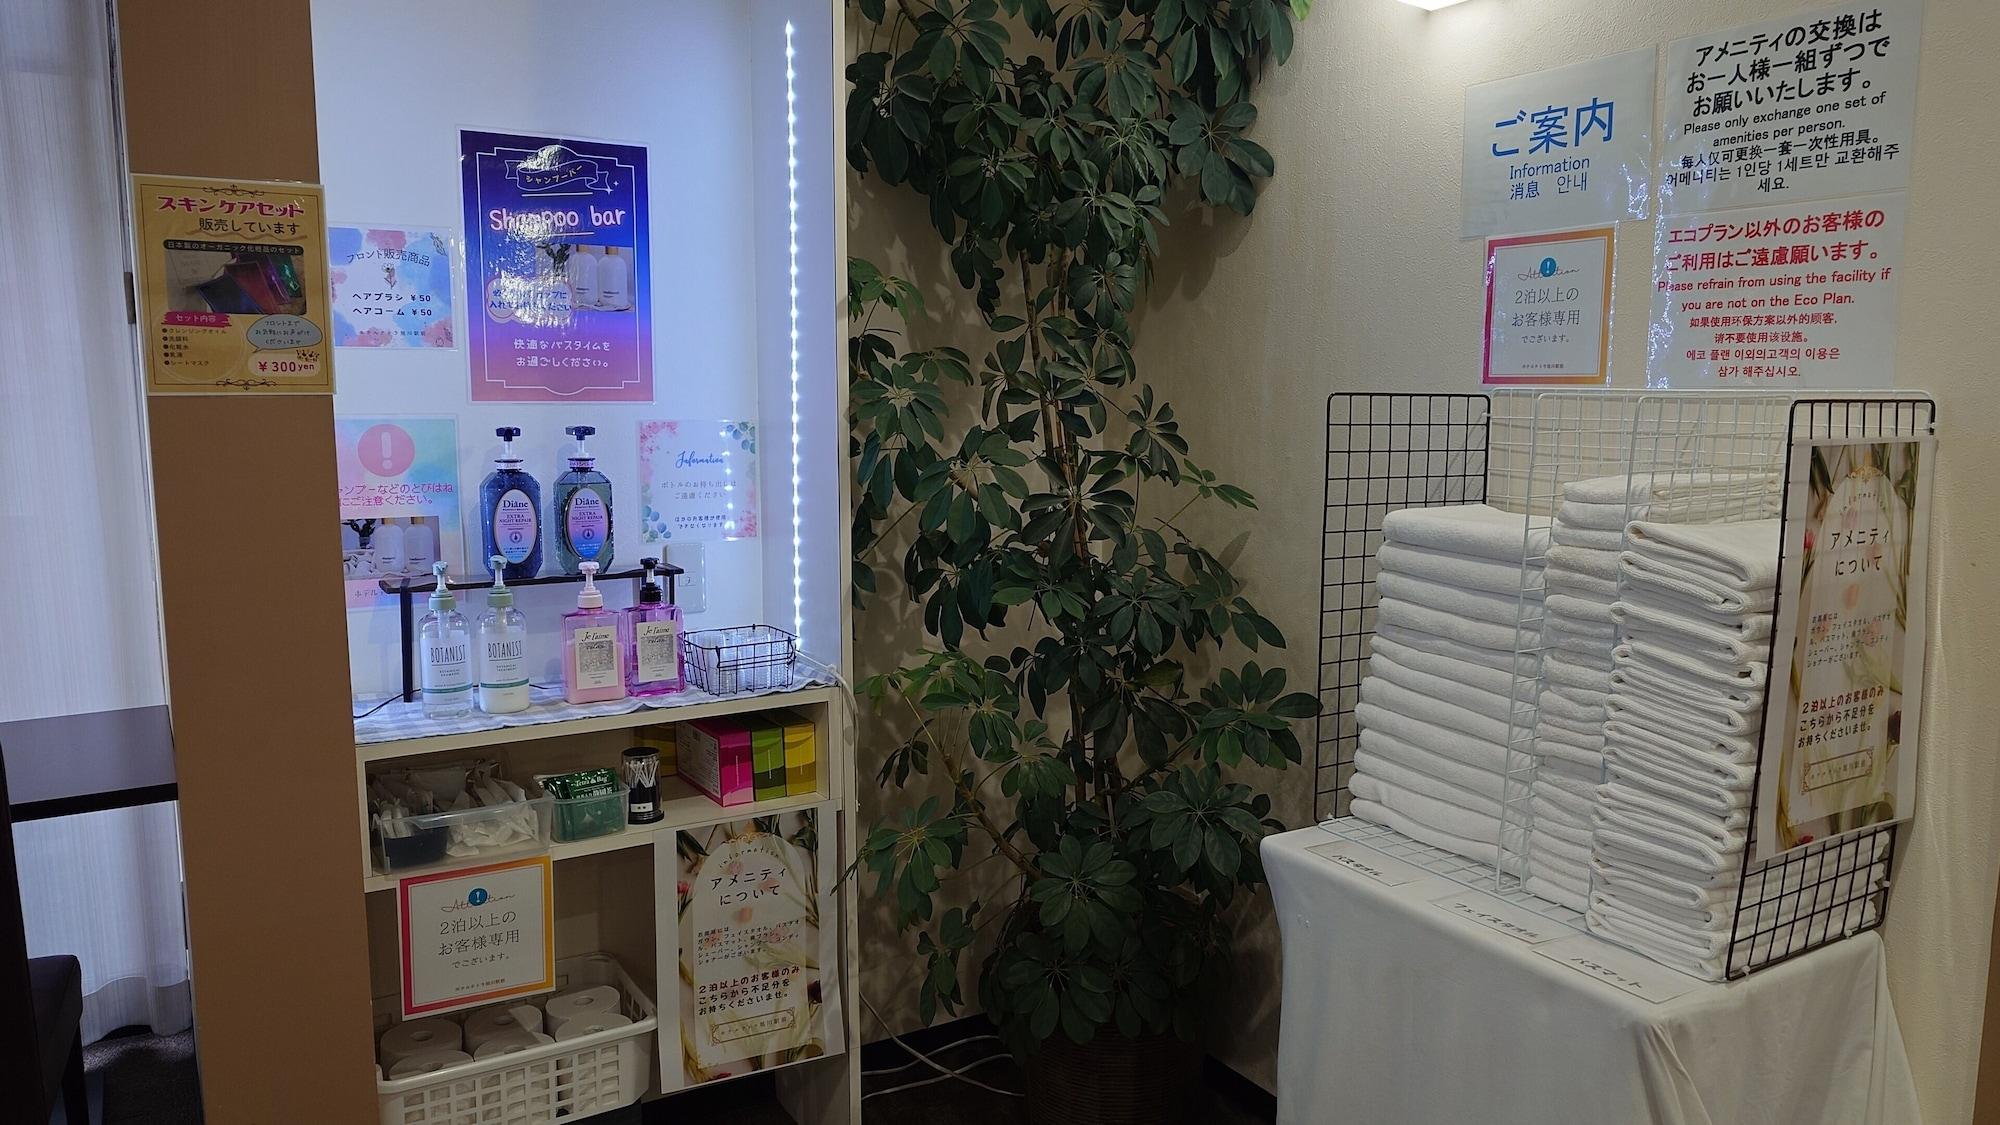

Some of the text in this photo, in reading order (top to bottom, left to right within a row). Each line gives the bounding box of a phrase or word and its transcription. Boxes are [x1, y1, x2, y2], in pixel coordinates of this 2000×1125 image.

[1696, 8, 1883, 67] アメニティの交換は
[1686, 35, 1891, 94] お一人様一組ずつで
[1692, 67, 1871, 117] お願いいたします。
[1684, 91, 1887, 135] Please only exchange one set of
[1491, 96, 1615, 157] ご案内
[1712, 119, 1846, 148] amenities per person.
[1509, 156, 1590, 180] Information
[1737, 160, 1772, 178] 1인당
[1777, 153, 1831, 173] 1세트만
[1834, 142, 1901, 166] 교환해주
[1510, 171, 1588, 200] 消息 안내
[1757, 176, 1790, 193] 세요.
[157, 196, 304, 218] スキンケアセット
[590, 205, 626, 226] bar
[200, 217, 300, 236] 販売しています
[1668, 209, 1885, 244] エコプラン以外のお客様の
[346, 248, 431, 267] フロント販売商品
[1666, 239, 1878, 272] ご利用はご遠慮願います。
[1657, 267, 1892, 292] Please refrain from using the facility if
[352, 292, 431, 302] ヘアブラシ ¥50
[1514, 287, 1580, 305] 2泊以上の
[1681, 292, 1855, 312] you are not on the Eco Plan.
[176, 314, 217, 323] セット内容
[352, 307, 405, 316] ヘアコーム
[1511, 309, 1581, 327] お客様専用
[513, 338, 611, 352] 快適なバスタイムを
[1686, 349, 1707, 361] 에코
[1710, 349, 1730, 361] 플랜
[1805, 348, 1841, 360] 이용은
[515, 355, 609, 368] お過ごしください。
[1717, 365, 1802, 378] 삼가 해주십시오.
[1830, 528, 1889, 550] アメニティ
[1834, 555, 1882, 577] について
[430, 644, 466, 663] BOTANIST
[487, 640, 522, 659] BOTANIST
[1799, 703, 1875, 732] こちらから不足分を
[711, 867, 786, 890] アメニティ
[720, 884, 780, 907] について
[439, 911, 517, 936] 2泊以上の
[438, 929, 520, 956] お客様専用
[698, 965, 800, 994] 2泊以上のお客様のみ
[698, 978, 791, 1006] こちらから不足分を
[698, 990, 788, 1016] お持ちくださいませ。
